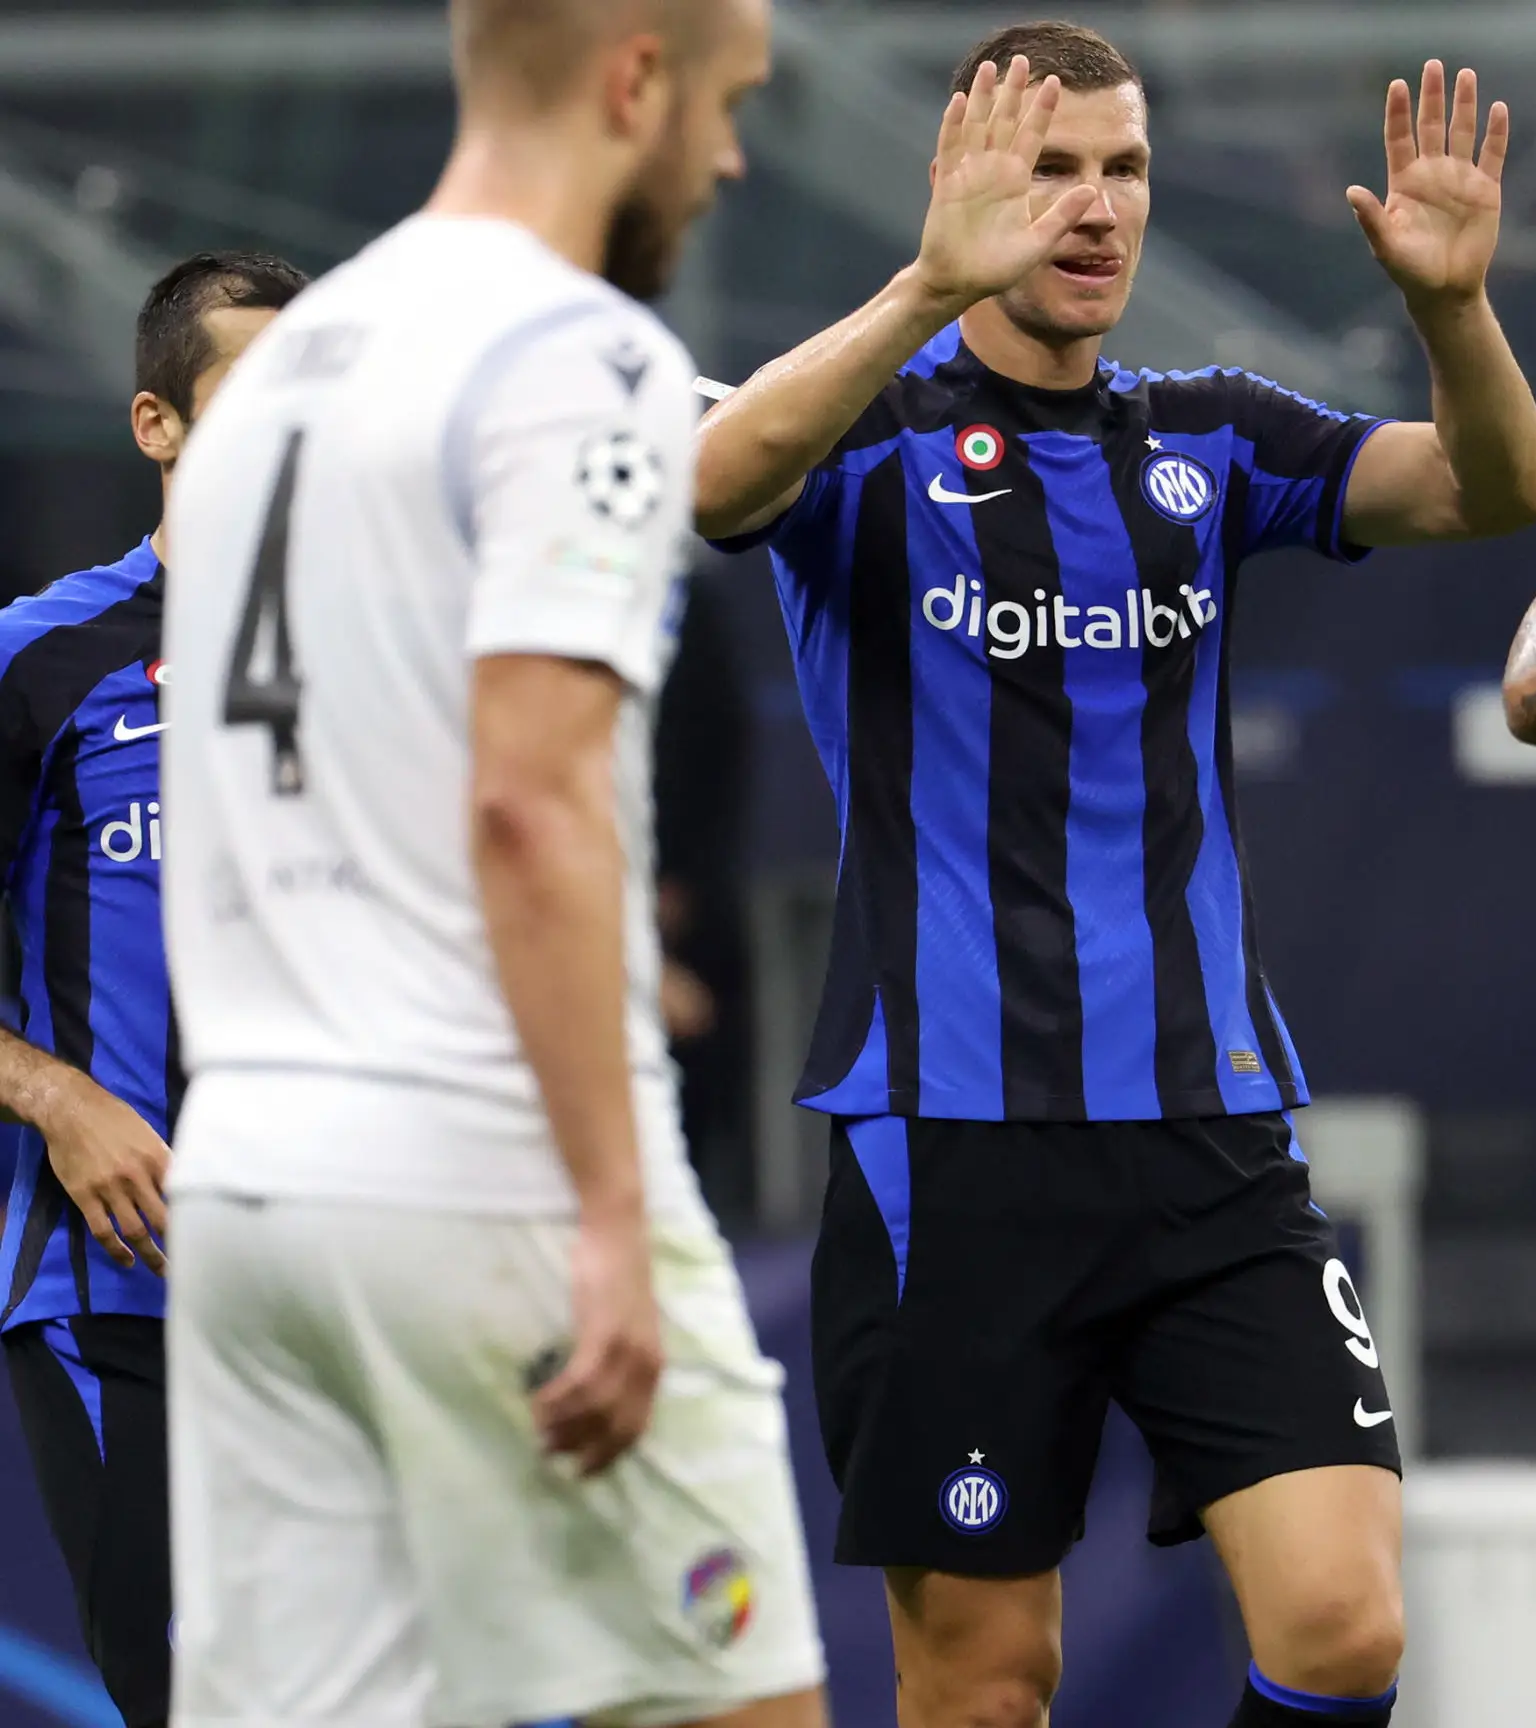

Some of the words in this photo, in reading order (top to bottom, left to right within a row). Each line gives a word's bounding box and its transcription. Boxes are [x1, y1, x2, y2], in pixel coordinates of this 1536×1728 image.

[223, 427, 308, 796] 4
[922, 574, 1217, 659] digitalbit
[1322, 1258, 1379, 1369] 9
